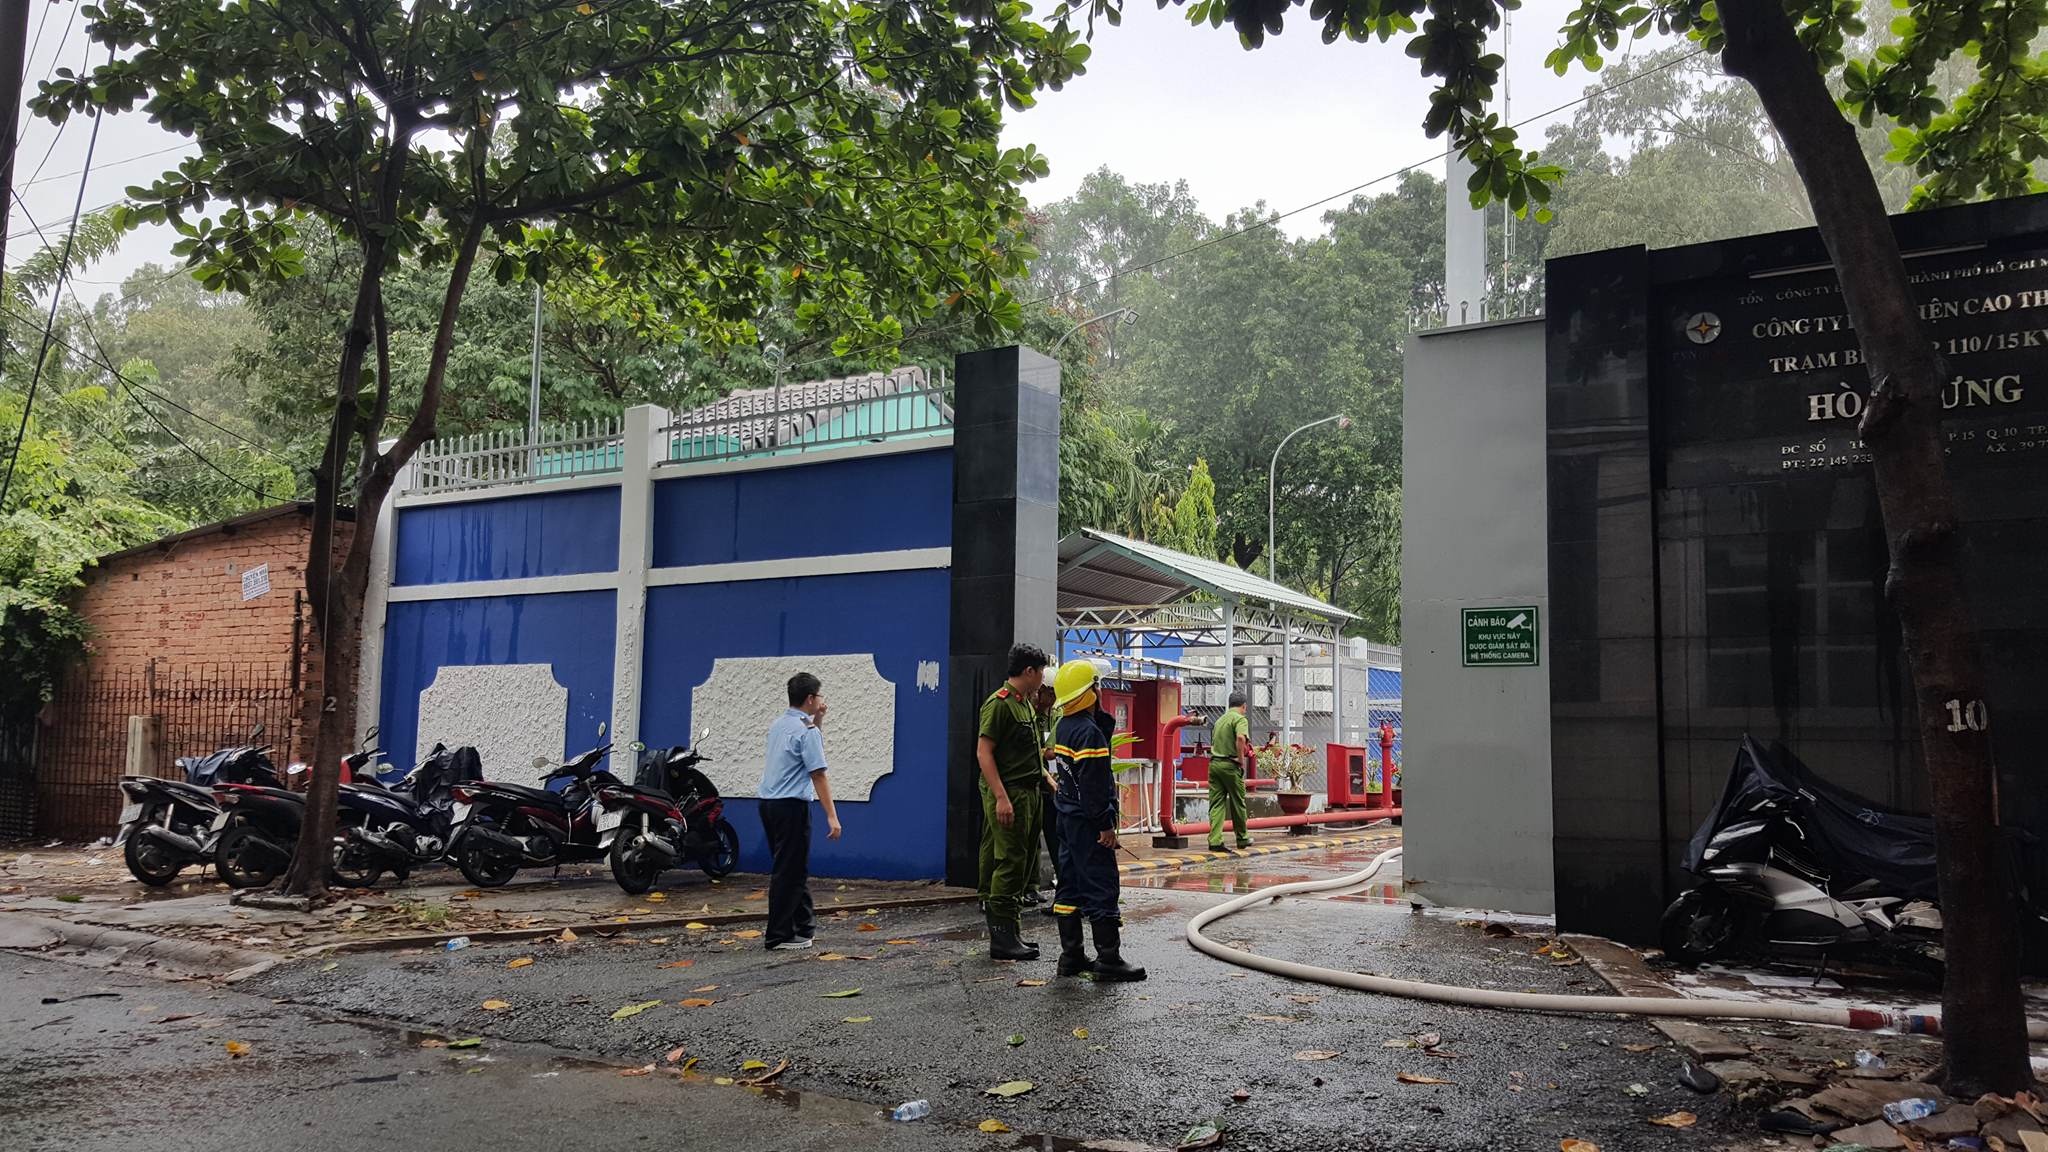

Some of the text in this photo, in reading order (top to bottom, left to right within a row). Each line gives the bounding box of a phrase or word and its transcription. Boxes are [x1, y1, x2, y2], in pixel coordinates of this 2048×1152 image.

[1752, 316, 1810, 339] CÔNG
[1813, 315, 1843, 333] TY
[1918, 297, 1959, 324] IỆN
[1963, 294, 2012, 316] CAO
[1769, 352, 1837, 374] TRẠM
[1807, 375, 2025, 422] HÒ ƯNG
[1468, 615, 1506, 627] CẢNH BÁO
[1492, 633, 1506, 641] VỰC
[1506, 632, 1520, 640] NÀY
[1480, 650, 1501, 659] THỐNG
[1945, 698, 1987, 732] 10
